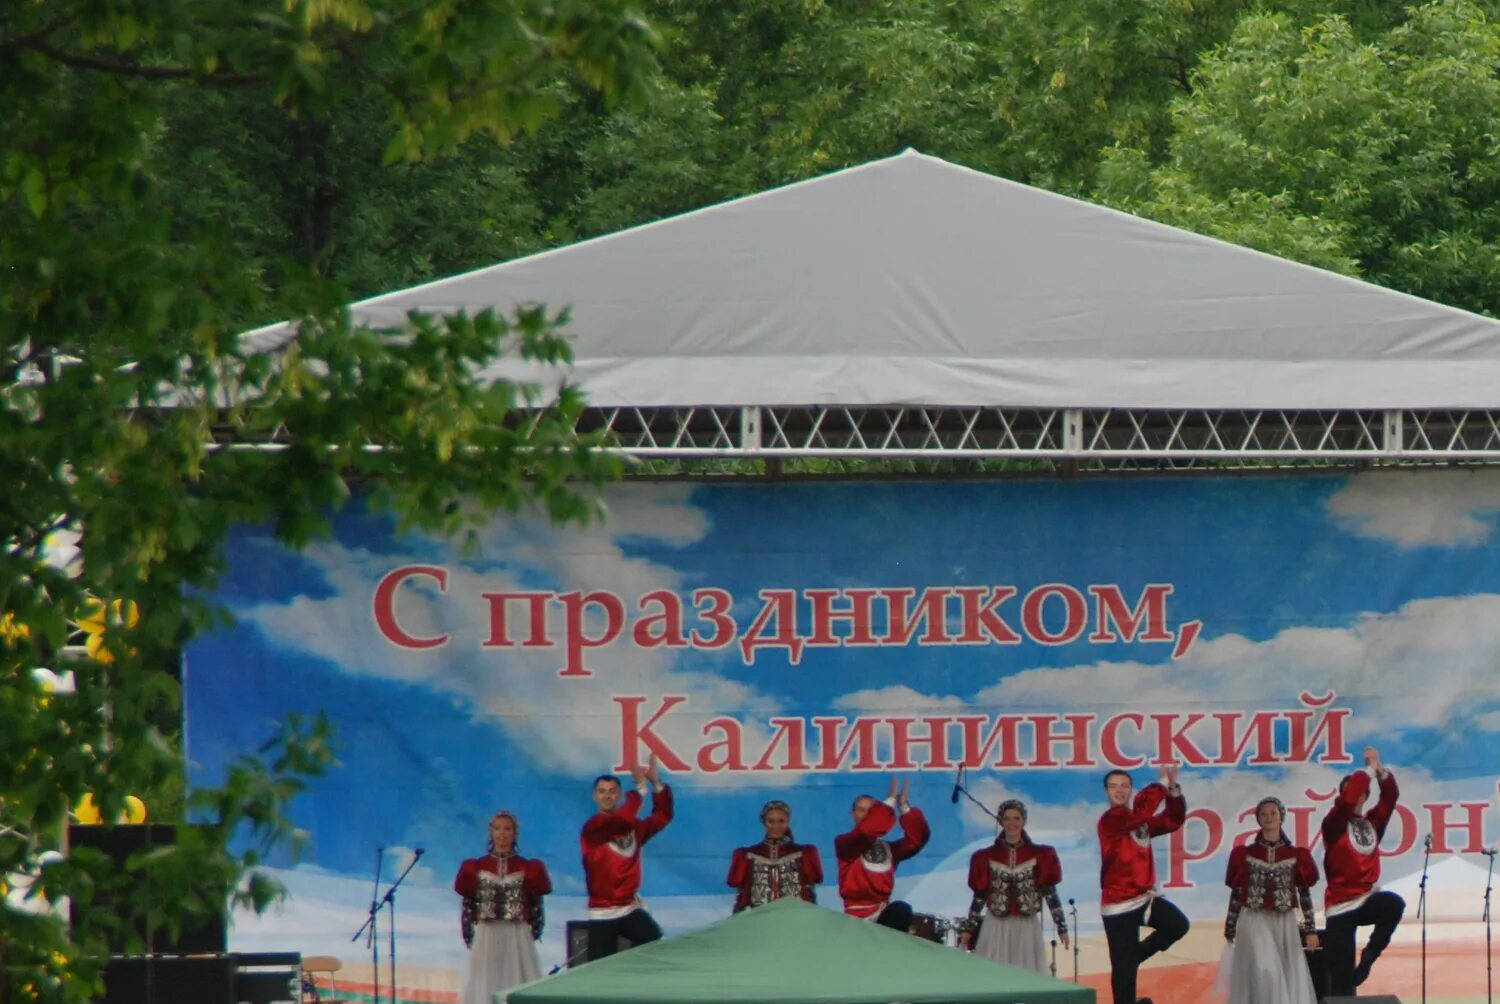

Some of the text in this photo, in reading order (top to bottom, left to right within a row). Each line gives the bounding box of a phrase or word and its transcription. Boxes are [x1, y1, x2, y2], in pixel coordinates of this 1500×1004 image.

[373, 566, 1203, 677] С праздником,
[613, 689, 1353, 774] Калининский
